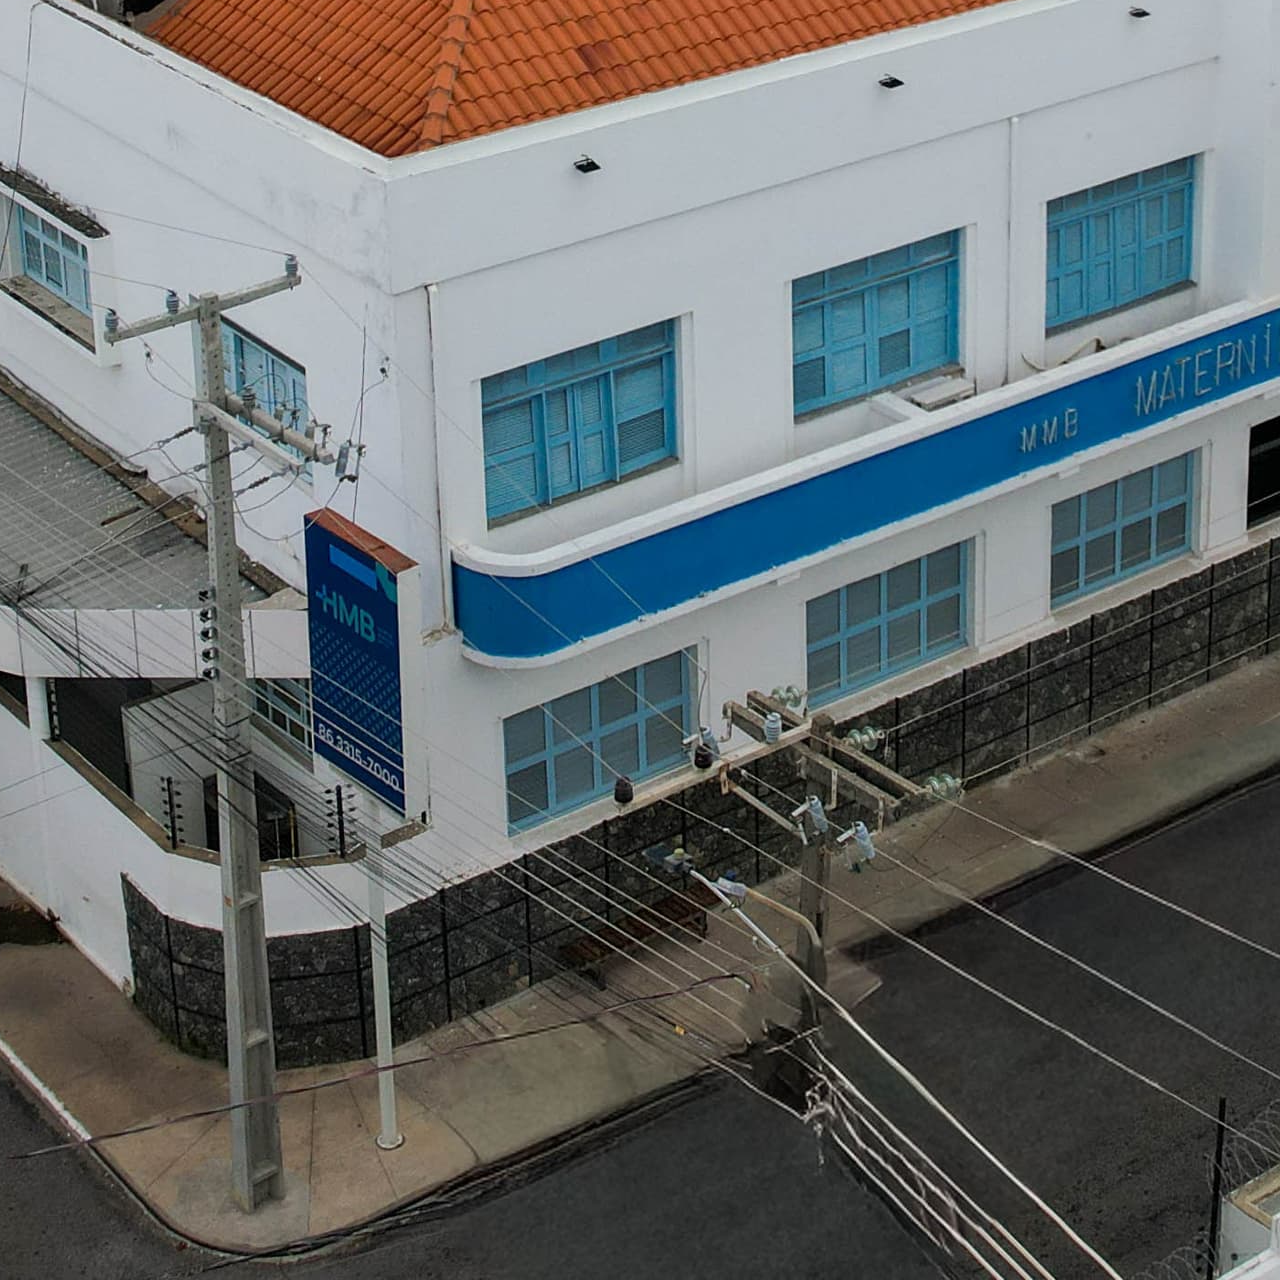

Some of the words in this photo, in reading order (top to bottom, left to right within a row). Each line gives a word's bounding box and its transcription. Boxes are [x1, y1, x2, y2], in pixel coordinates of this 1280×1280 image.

[316, 584, 376, 642] HMB
[318, 723, 334, 743] 86
[336, 736, 400, 791] 3315-7000
